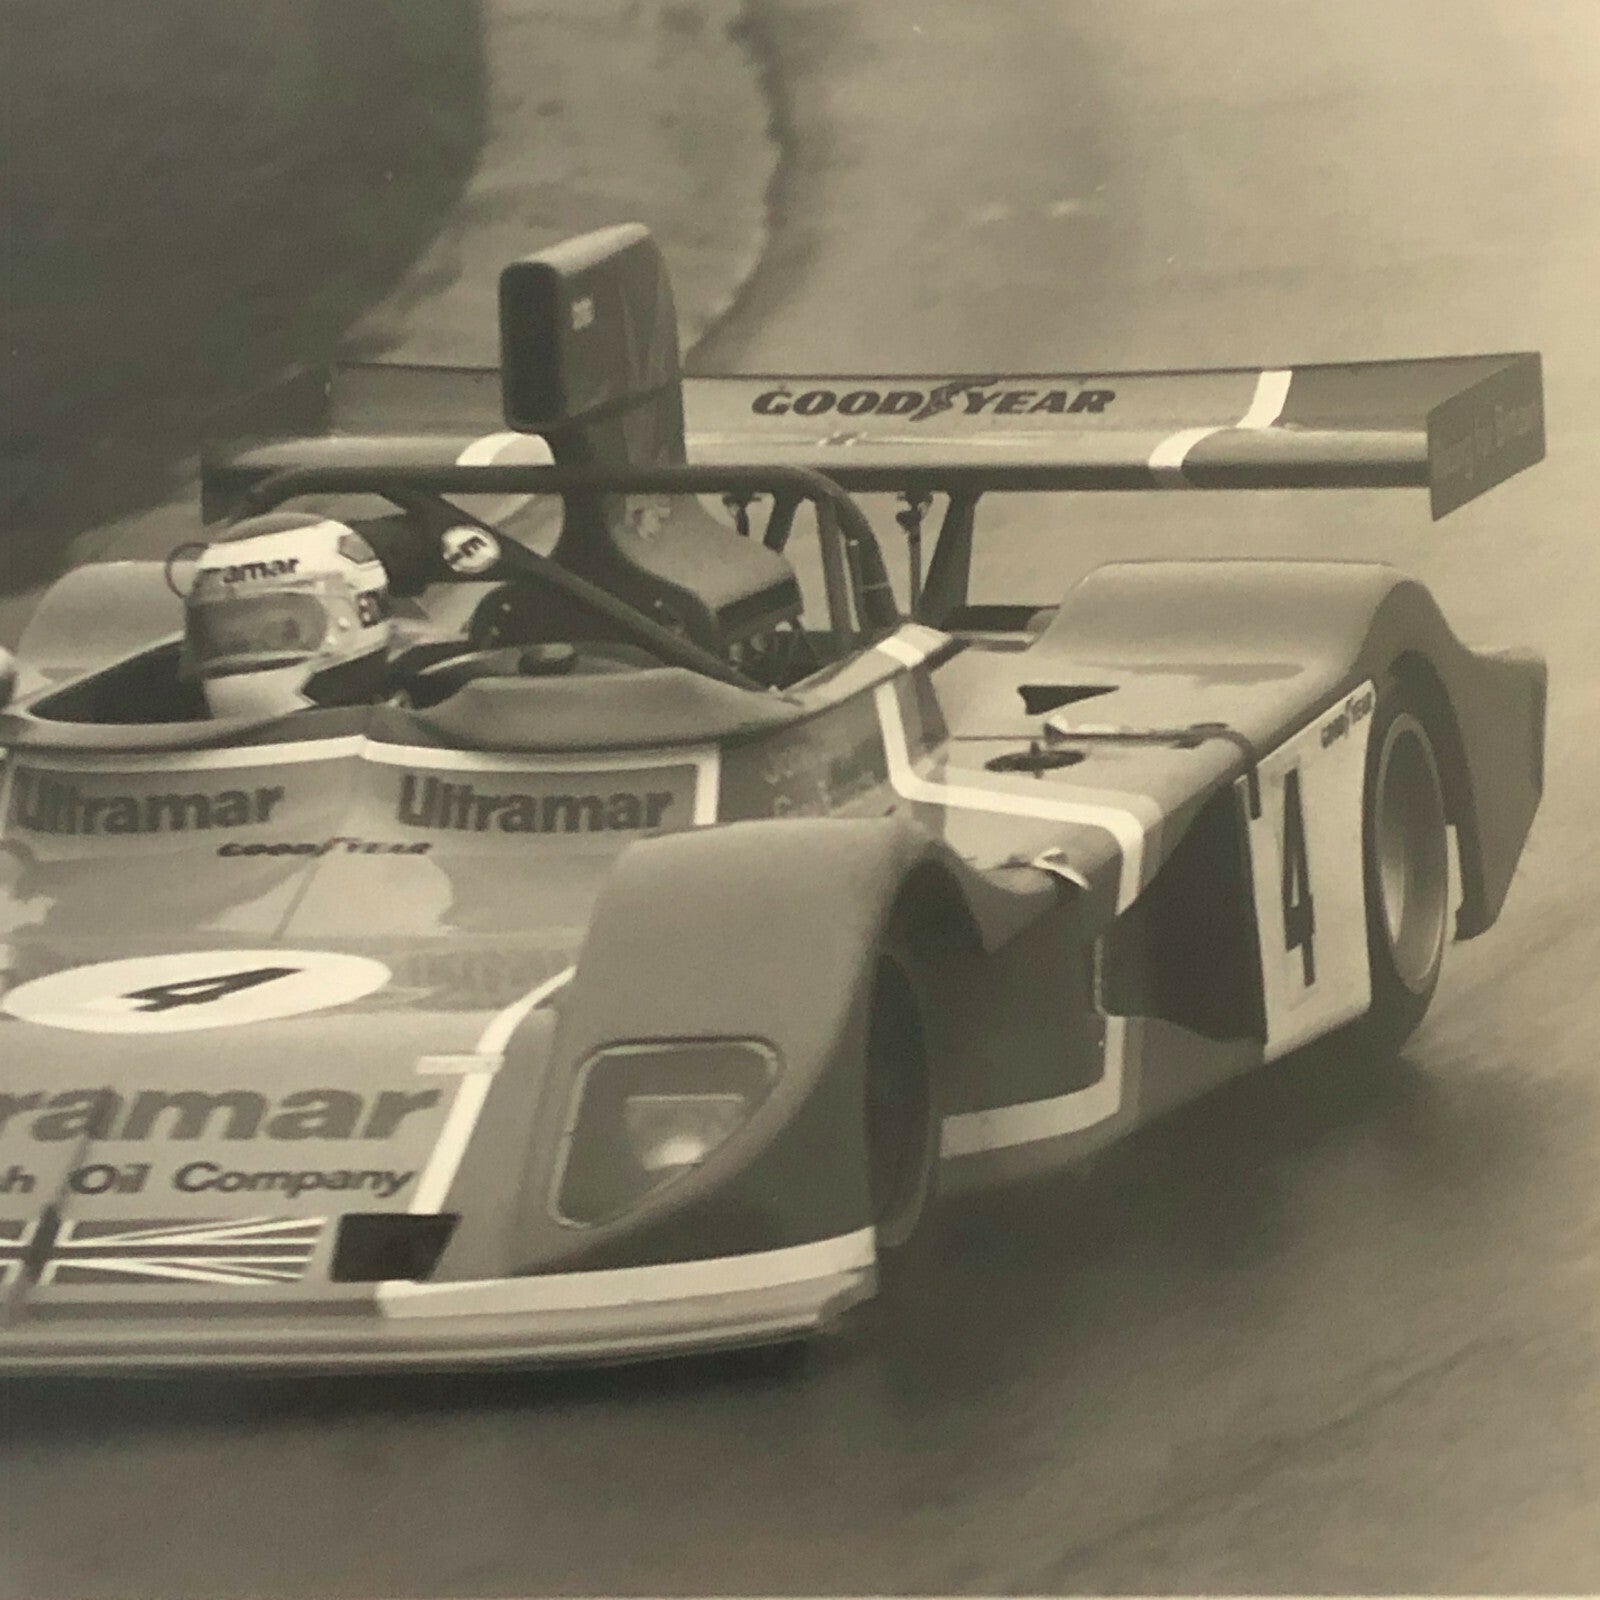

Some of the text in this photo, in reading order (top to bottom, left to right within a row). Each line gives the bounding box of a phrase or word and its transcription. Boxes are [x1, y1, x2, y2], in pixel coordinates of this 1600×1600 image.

[399, 774, 675, 833] Ultramar
[1282, 767, 1316, 989] 4
[118, 966, 305, 1013] 4
[69, 1163, 152, 1195] Oil
[172, 1161, 418, 1198] Company
